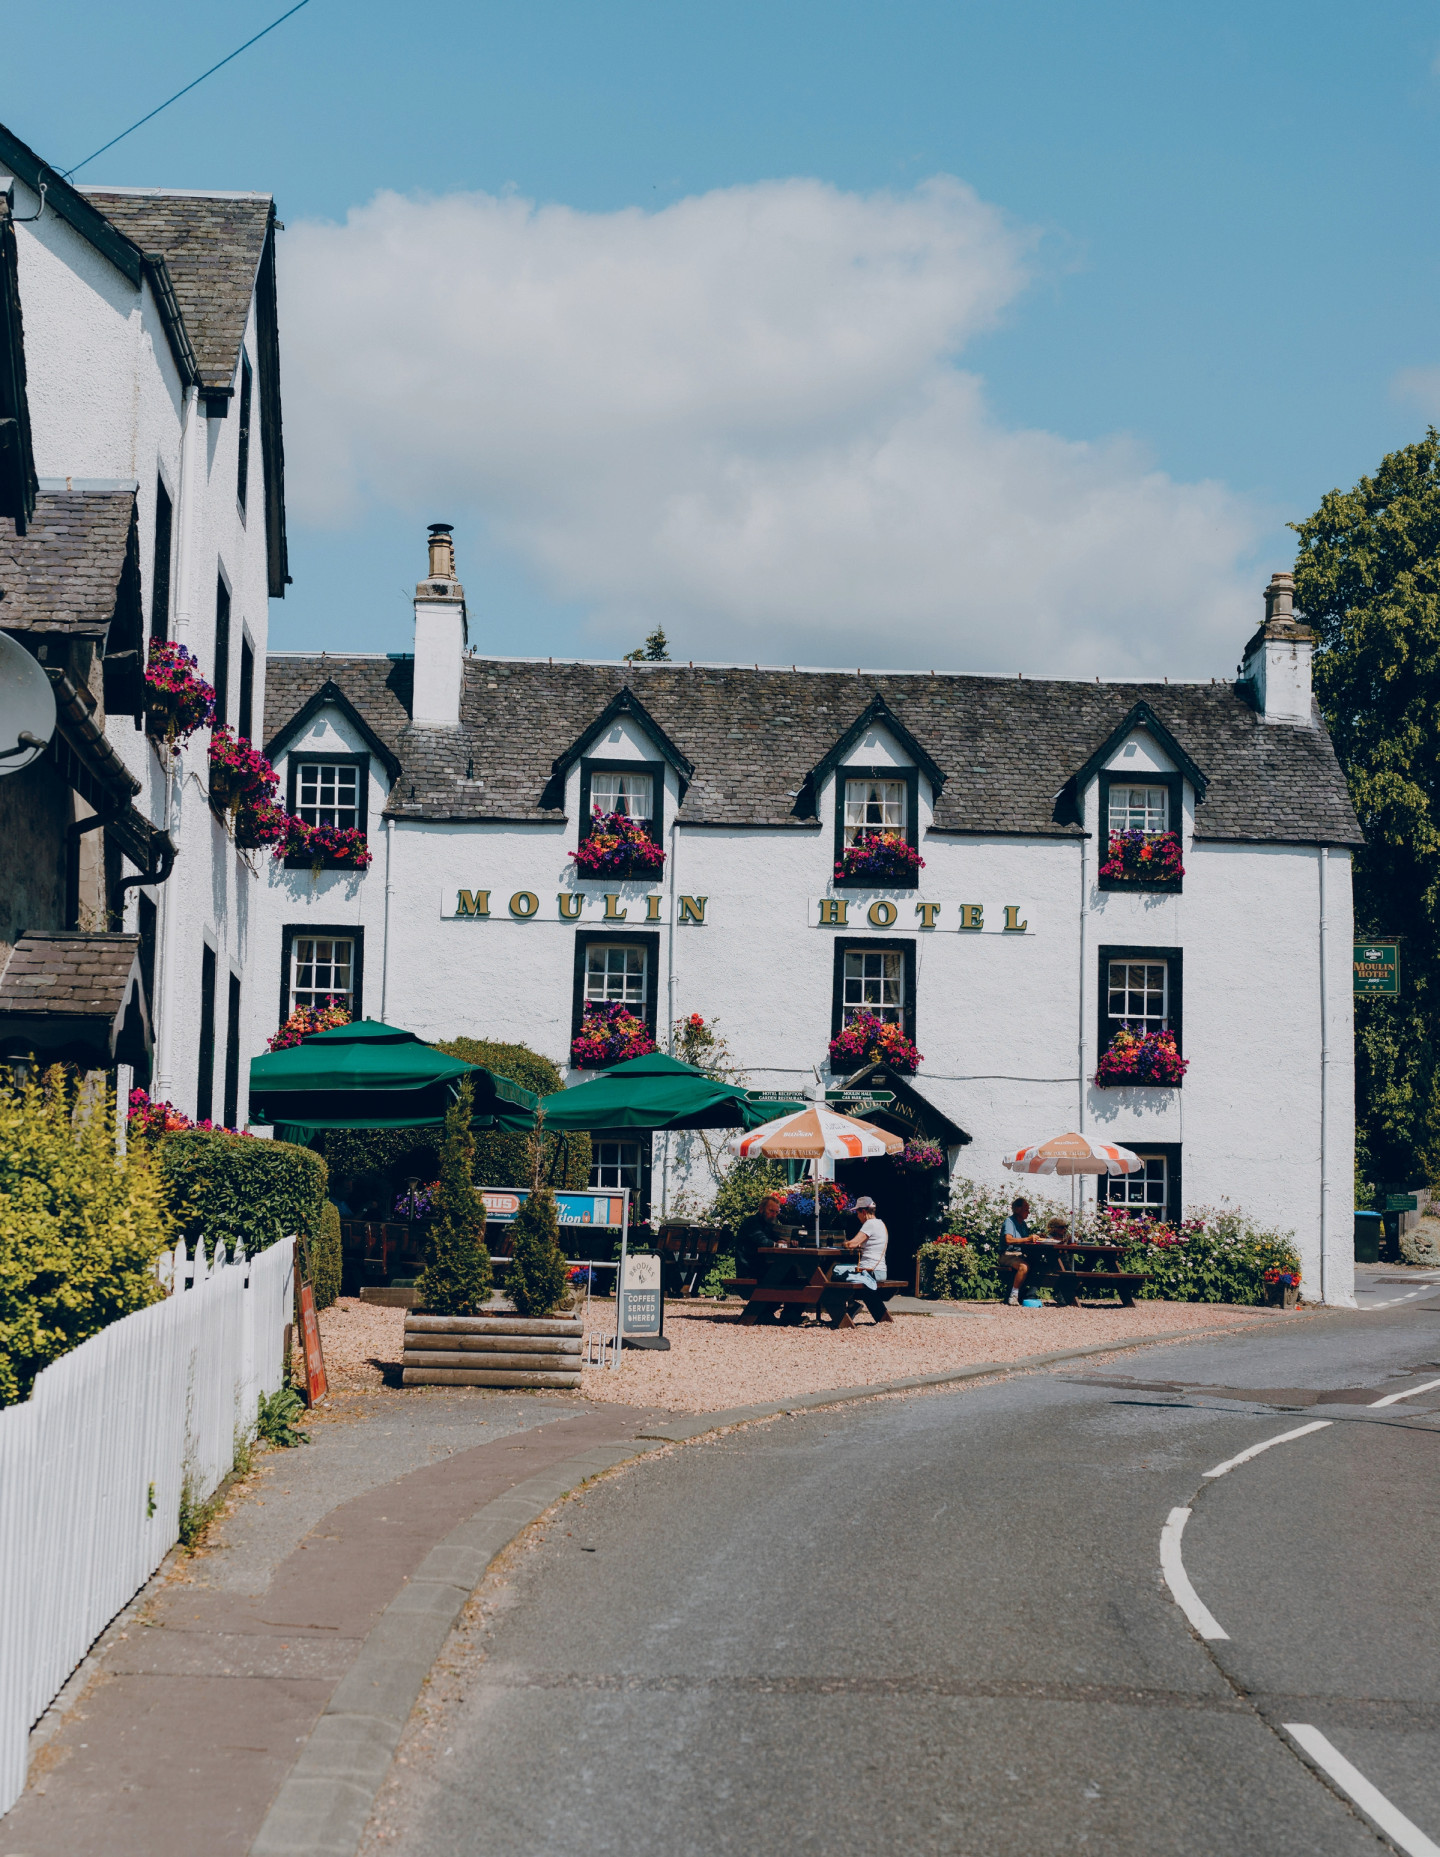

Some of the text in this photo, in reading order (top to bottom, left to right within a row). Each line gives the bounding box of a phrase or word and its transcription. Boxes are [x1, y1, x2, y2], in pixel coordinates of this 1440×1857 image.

[457, 889, 1028, 931] MOULIN HOTEL
[1353, 962, 1395, 971] MOULIN
[1358, 970, 1390, 978] HOTEL
[483, 1197, 512, 1209] BUS
[629, 1262, 656, 1278] BRODIES
[628, 1304, 656, 1312] SERVED
[632, 1314, 651, 1322] HERE
